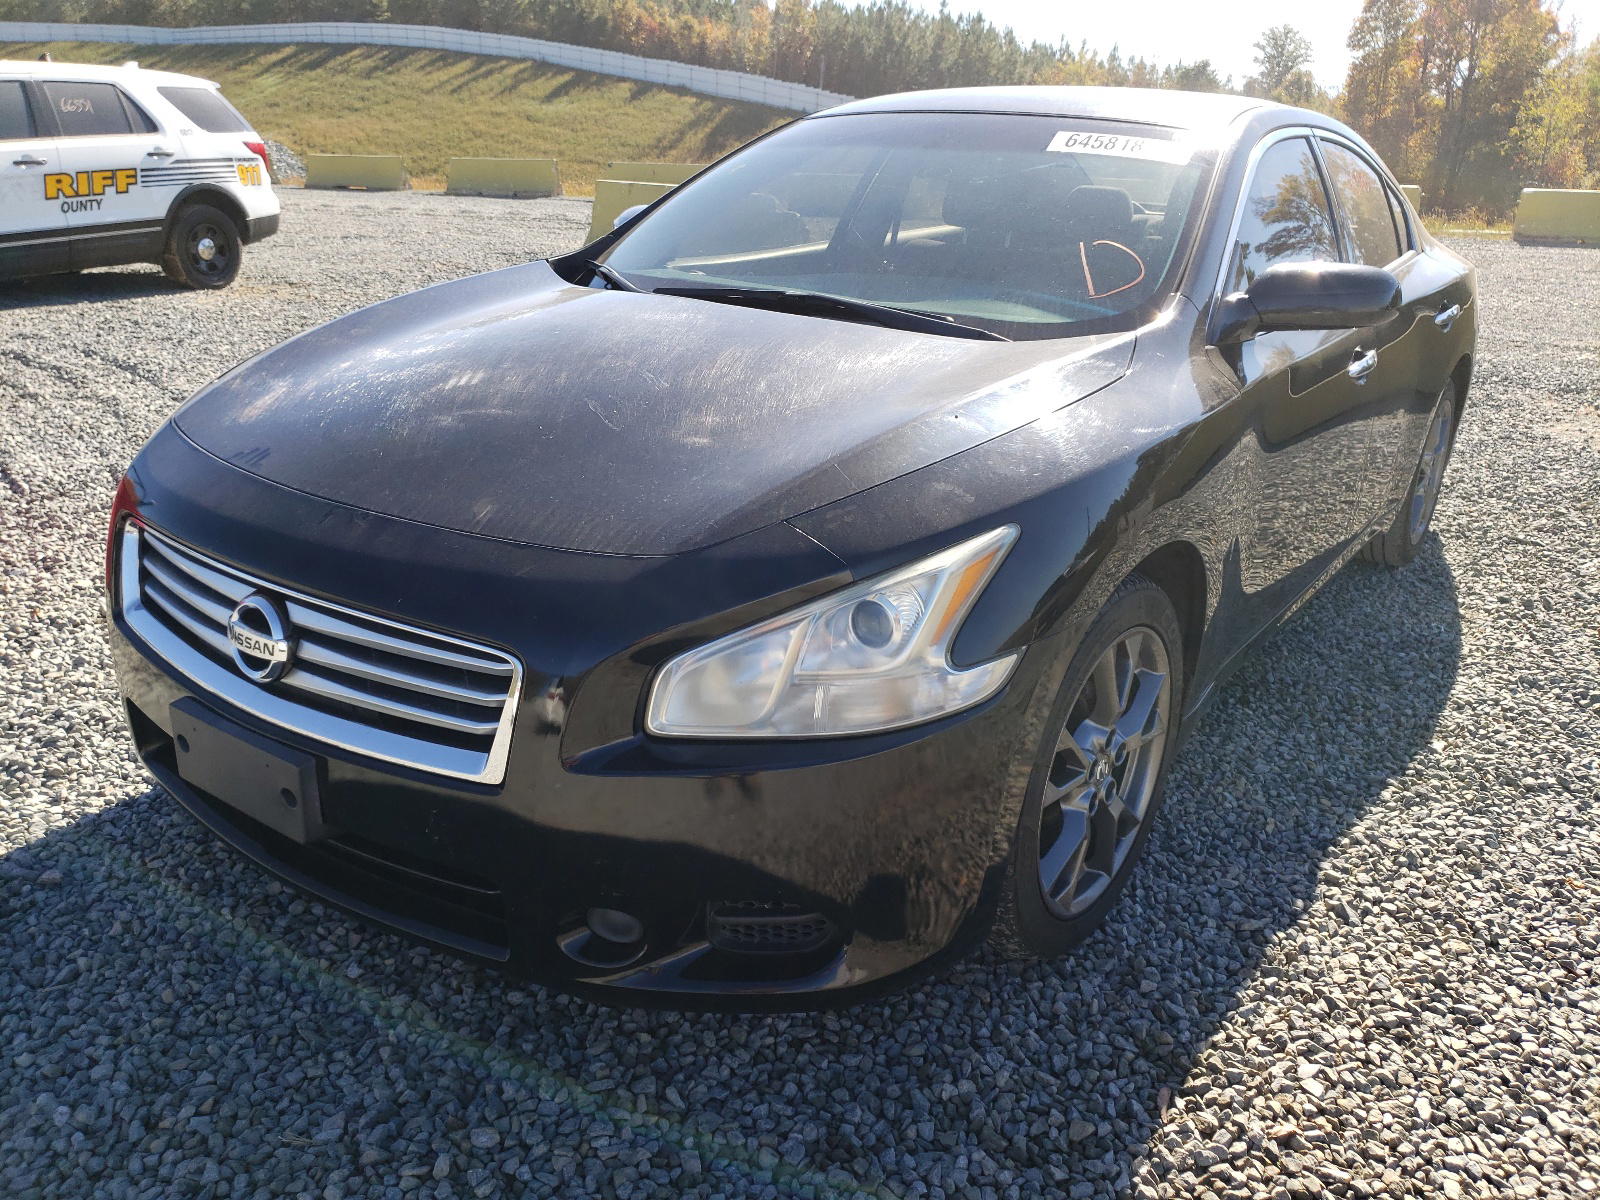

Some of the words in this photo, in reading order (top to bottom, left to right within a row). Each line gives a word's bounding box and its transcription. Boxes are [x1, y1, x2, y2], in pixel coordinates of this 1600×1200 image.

[44, 168, 138, 200] RIFF
[237, 164, 262, 186] 911
[61, 199, 103, 214] OUNTY
[1079, 239, 1145, 299] D
[228, 622, 275, 656] NISSAN
